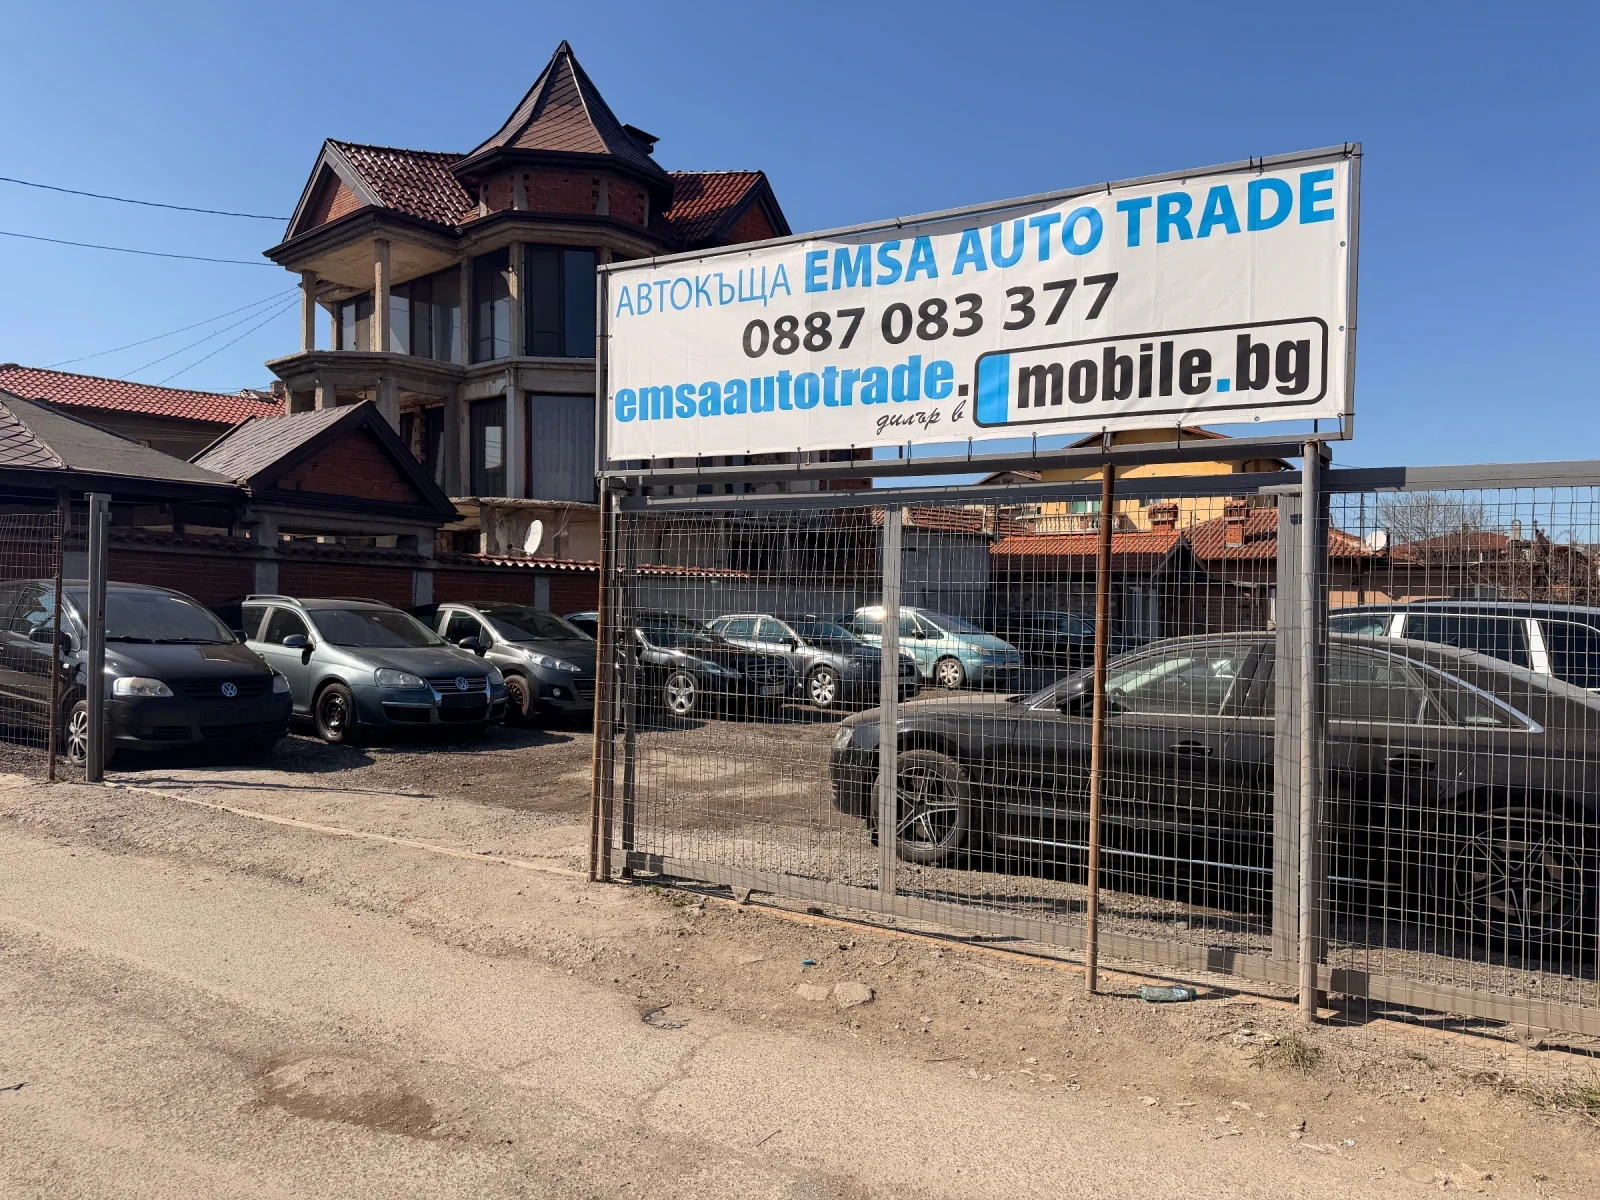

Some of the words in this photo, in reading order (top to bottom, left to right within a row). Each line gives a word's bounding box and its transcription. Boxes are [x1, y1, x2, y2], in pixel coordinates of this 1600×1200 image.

[616, 265, 790, 316] АВТОКЪЩА
[805, 240, 939, 293] EMSA
[953, 206, 1103, 276] AUTO
[1117, 168, 1335, 248] TRADE
[743, 308, 865, 359] 0887
[882, 294, 984, 345] 083
[1003, 272, 1119, 331] 377
[1018, 333, 1311, 409] mobile.bg
[876, 407, 941, 436] дилър
